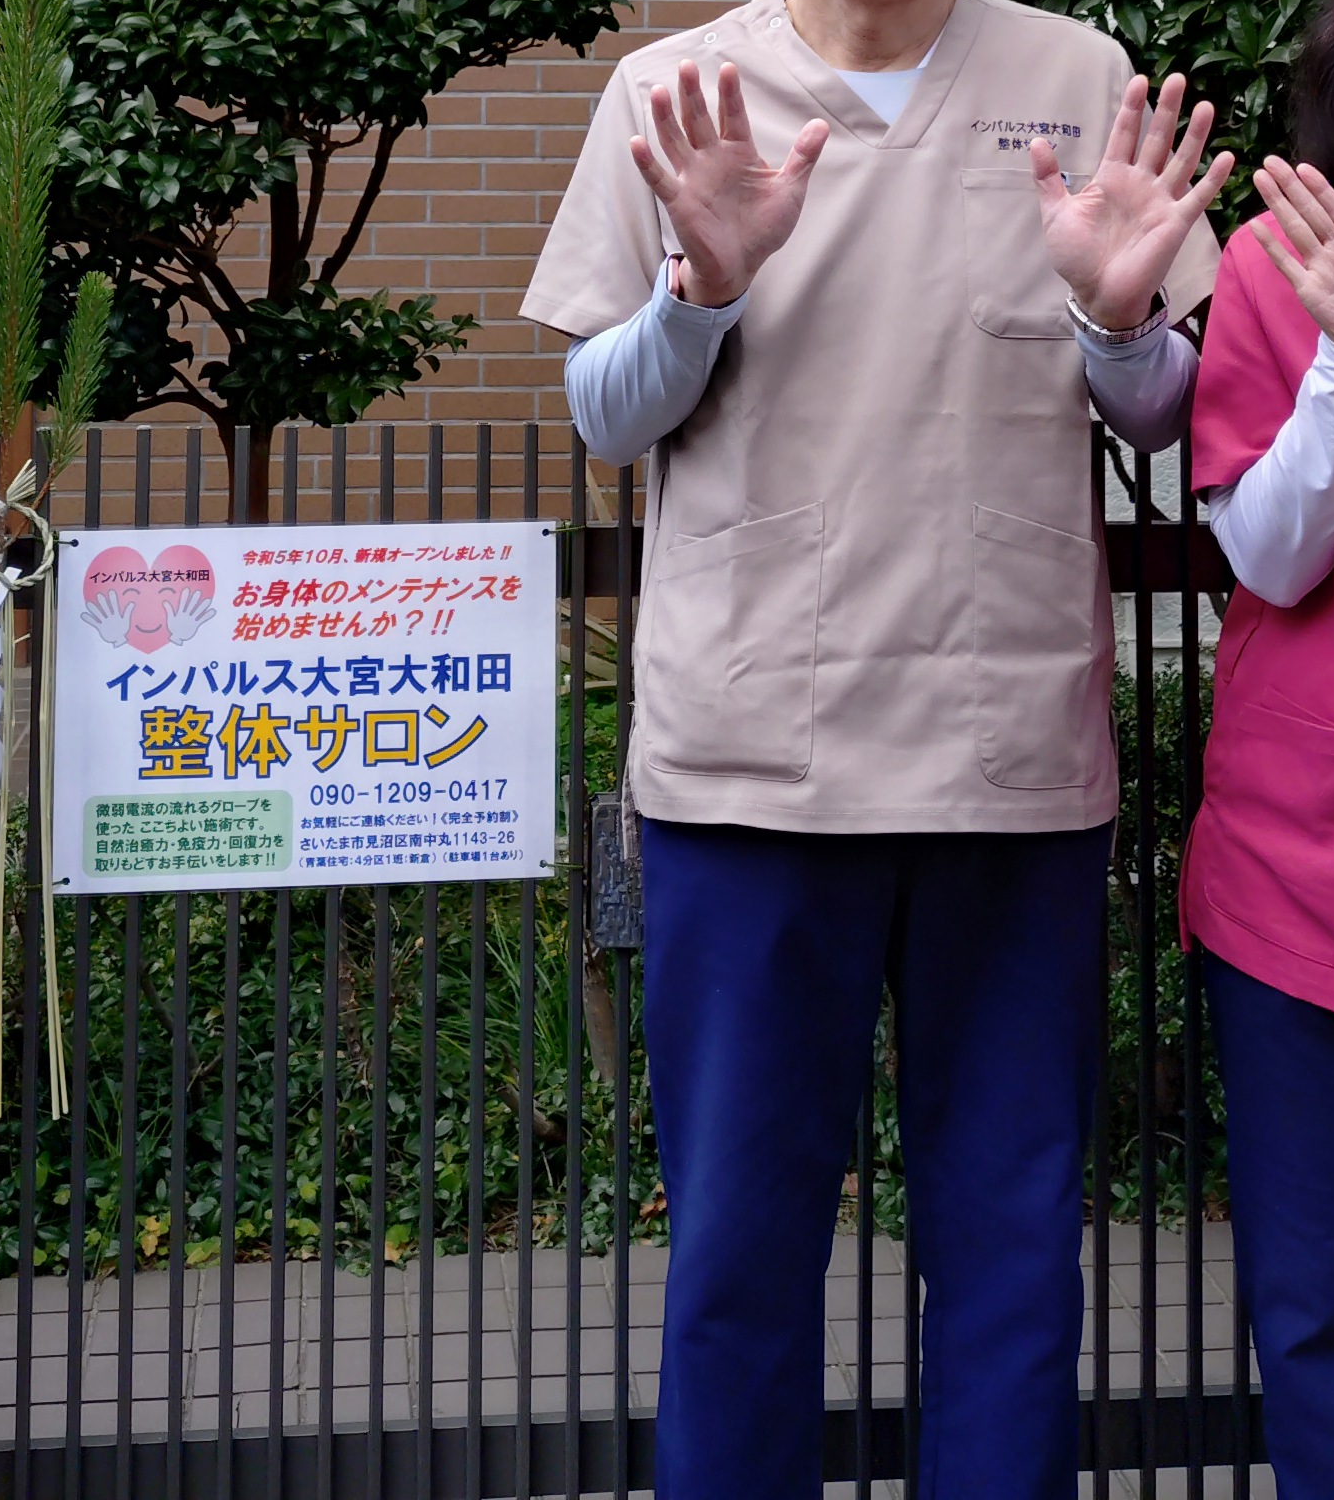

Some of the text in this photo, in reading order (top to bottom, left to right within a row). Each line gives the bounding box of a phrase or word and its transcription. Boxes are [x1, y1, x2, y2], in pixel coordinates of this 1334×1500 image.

[970, 119, 1081, 138] インパルス大宮大和田
[89, 569, 210, 583] インパルス大宮大和田
[232, 575, 522, 608] お身体のメンテナンスを
[106, 653, 512, 700] インパルス大宮大和田
[138, 702, 489, 780] 整体サロン
[309, 778, 508, 806] 090-1209-0417
[95, 798, 272, 818] 微弱電流の流れるグローブを
[300, 831, 515, 851] さいたま市見沼区南中丸1143-26
